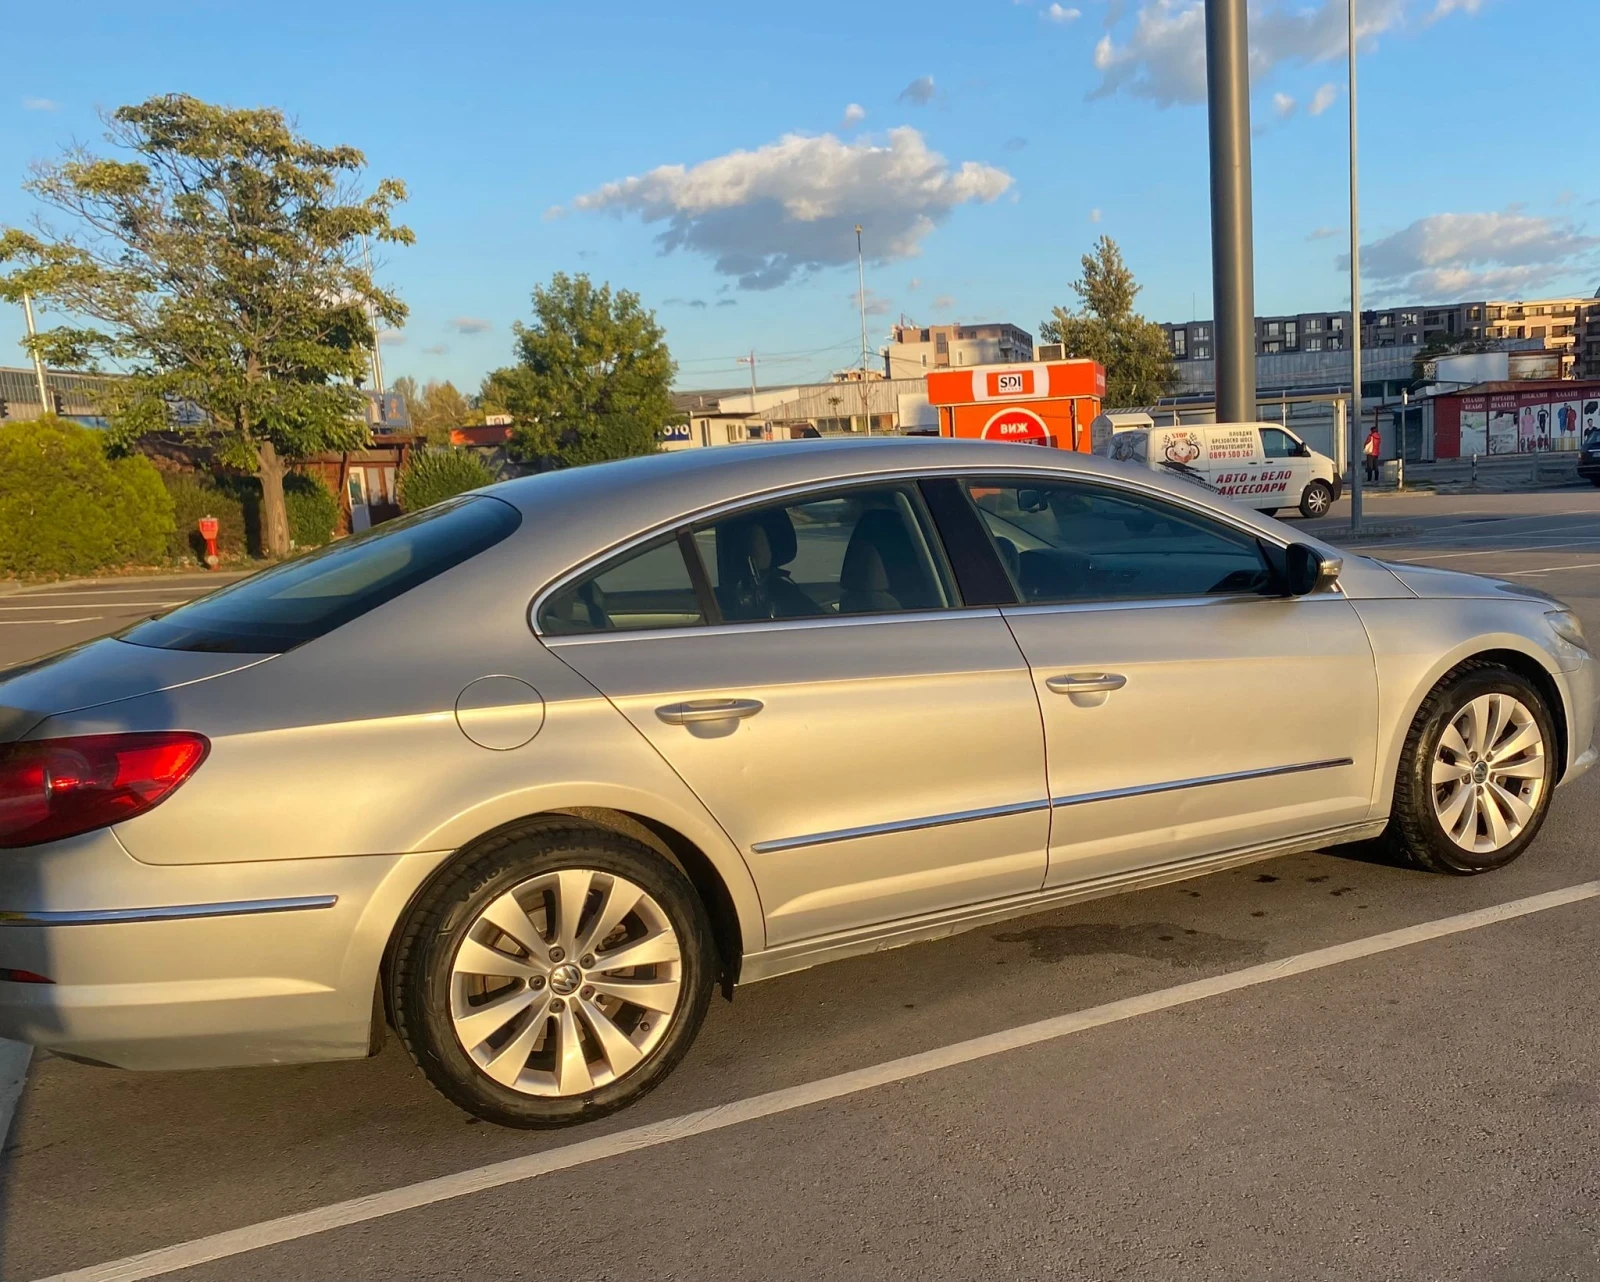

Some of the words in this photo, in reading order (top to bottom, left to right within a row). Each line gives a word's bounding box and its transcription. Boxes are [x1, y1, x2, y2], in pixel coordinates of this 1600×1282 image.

[1000, 376, 1021, 388] SDI
[1000, 423, 1029, 434] ВИЖ
[1216, 473, 1248, 484] АВТО
[1260, 470, 1292, 481] ВЕЛО
[1217, 482, 1287, 495] АКСЕСОАРИ
